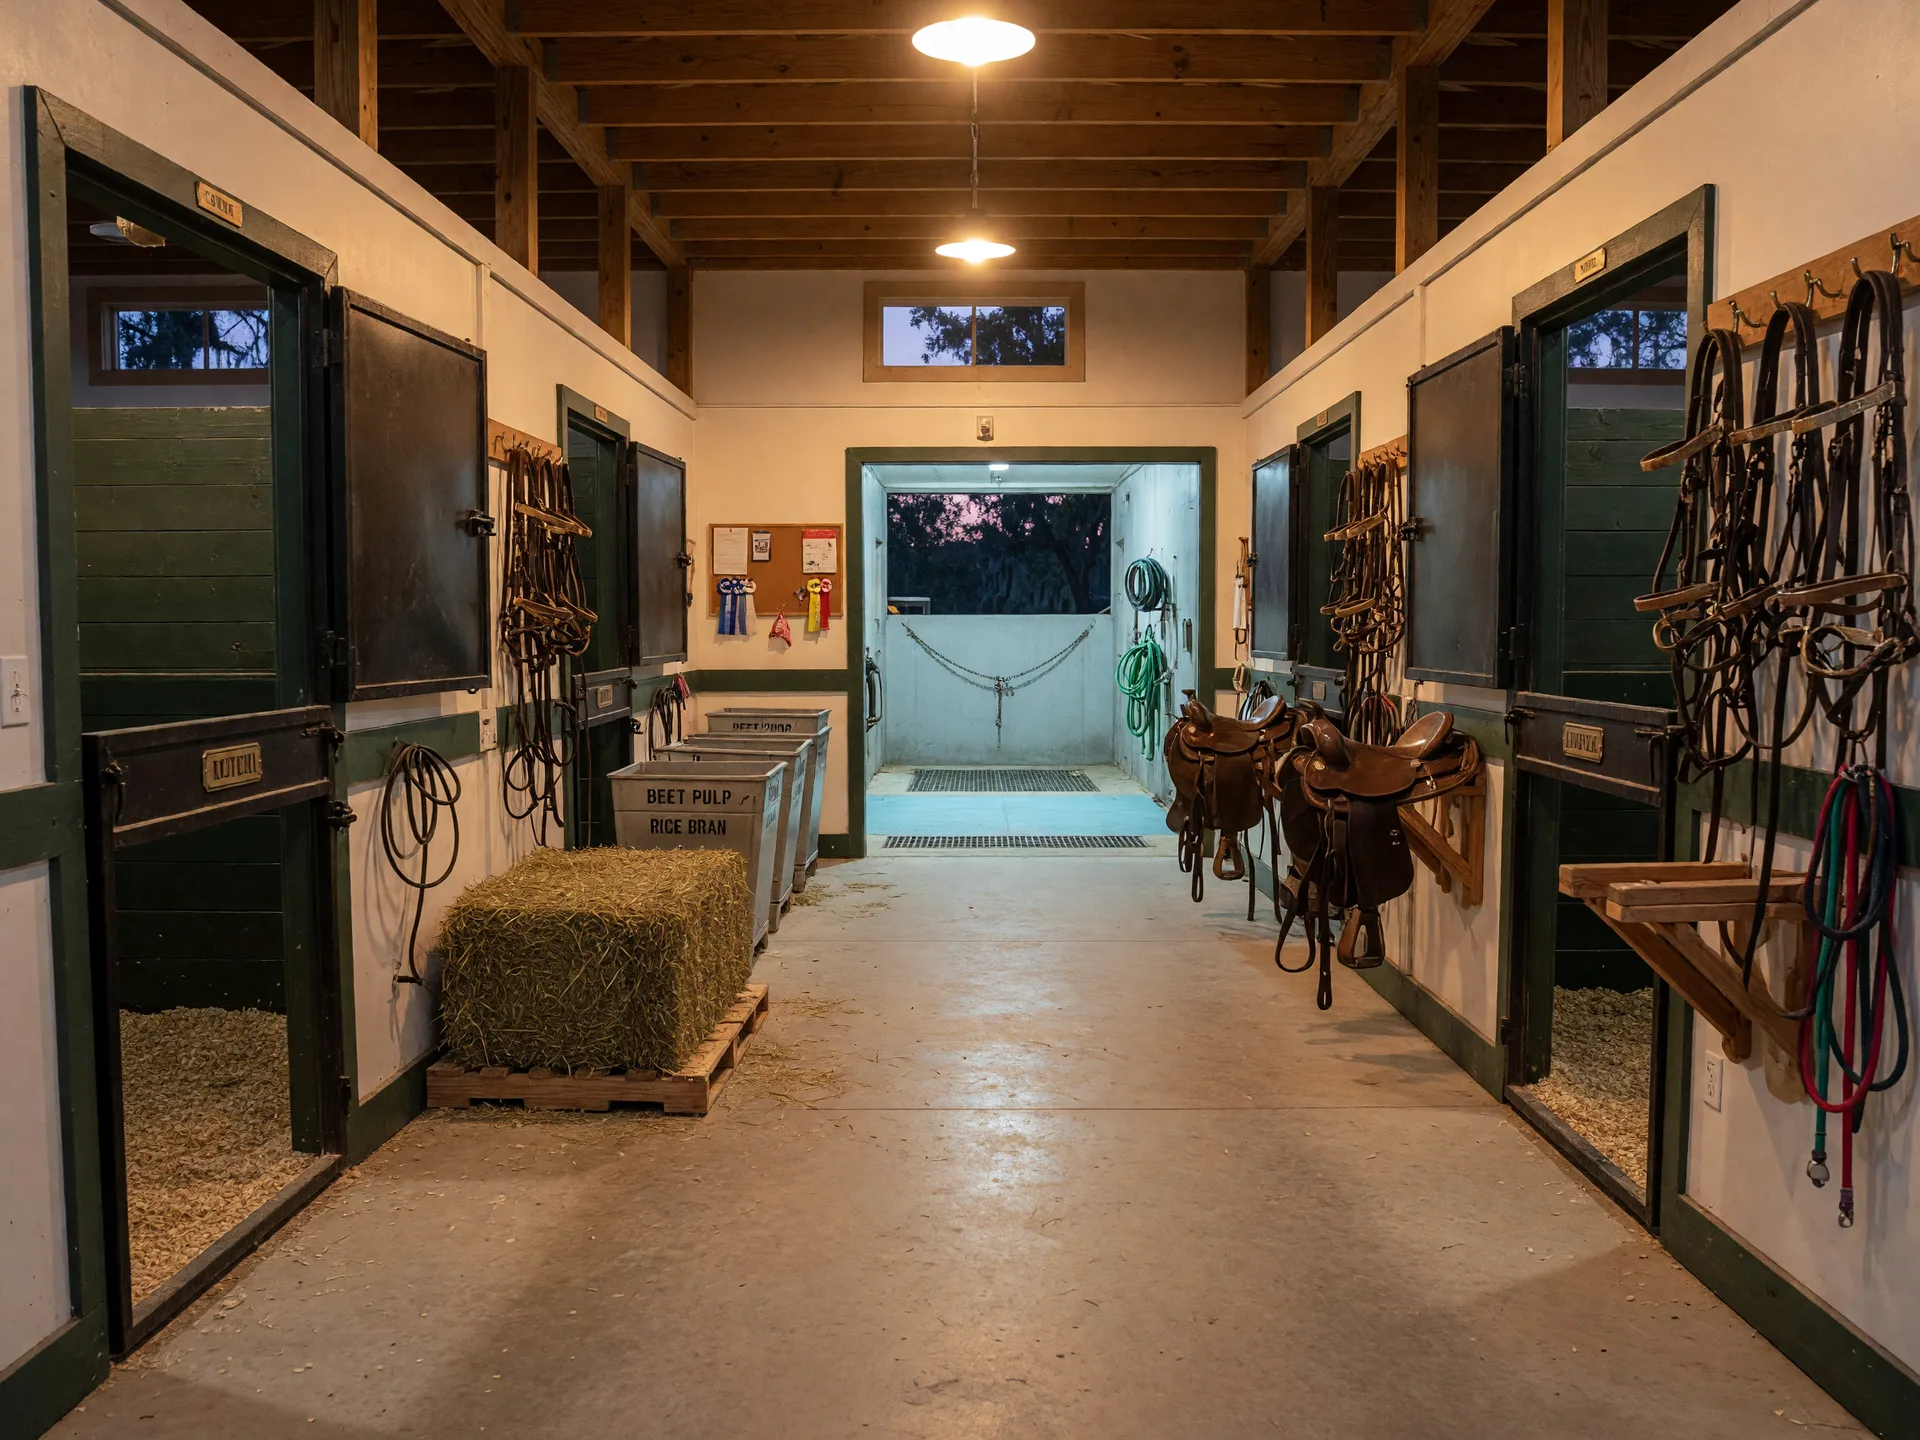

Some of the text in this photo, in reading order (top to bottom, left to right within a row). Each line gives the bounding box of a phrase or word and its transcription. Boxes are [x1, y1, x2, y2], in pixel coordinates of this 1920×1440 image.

[647, 789, 731, 804] BEET PULP
[650, 819, 726, 835] RICE BRAN
